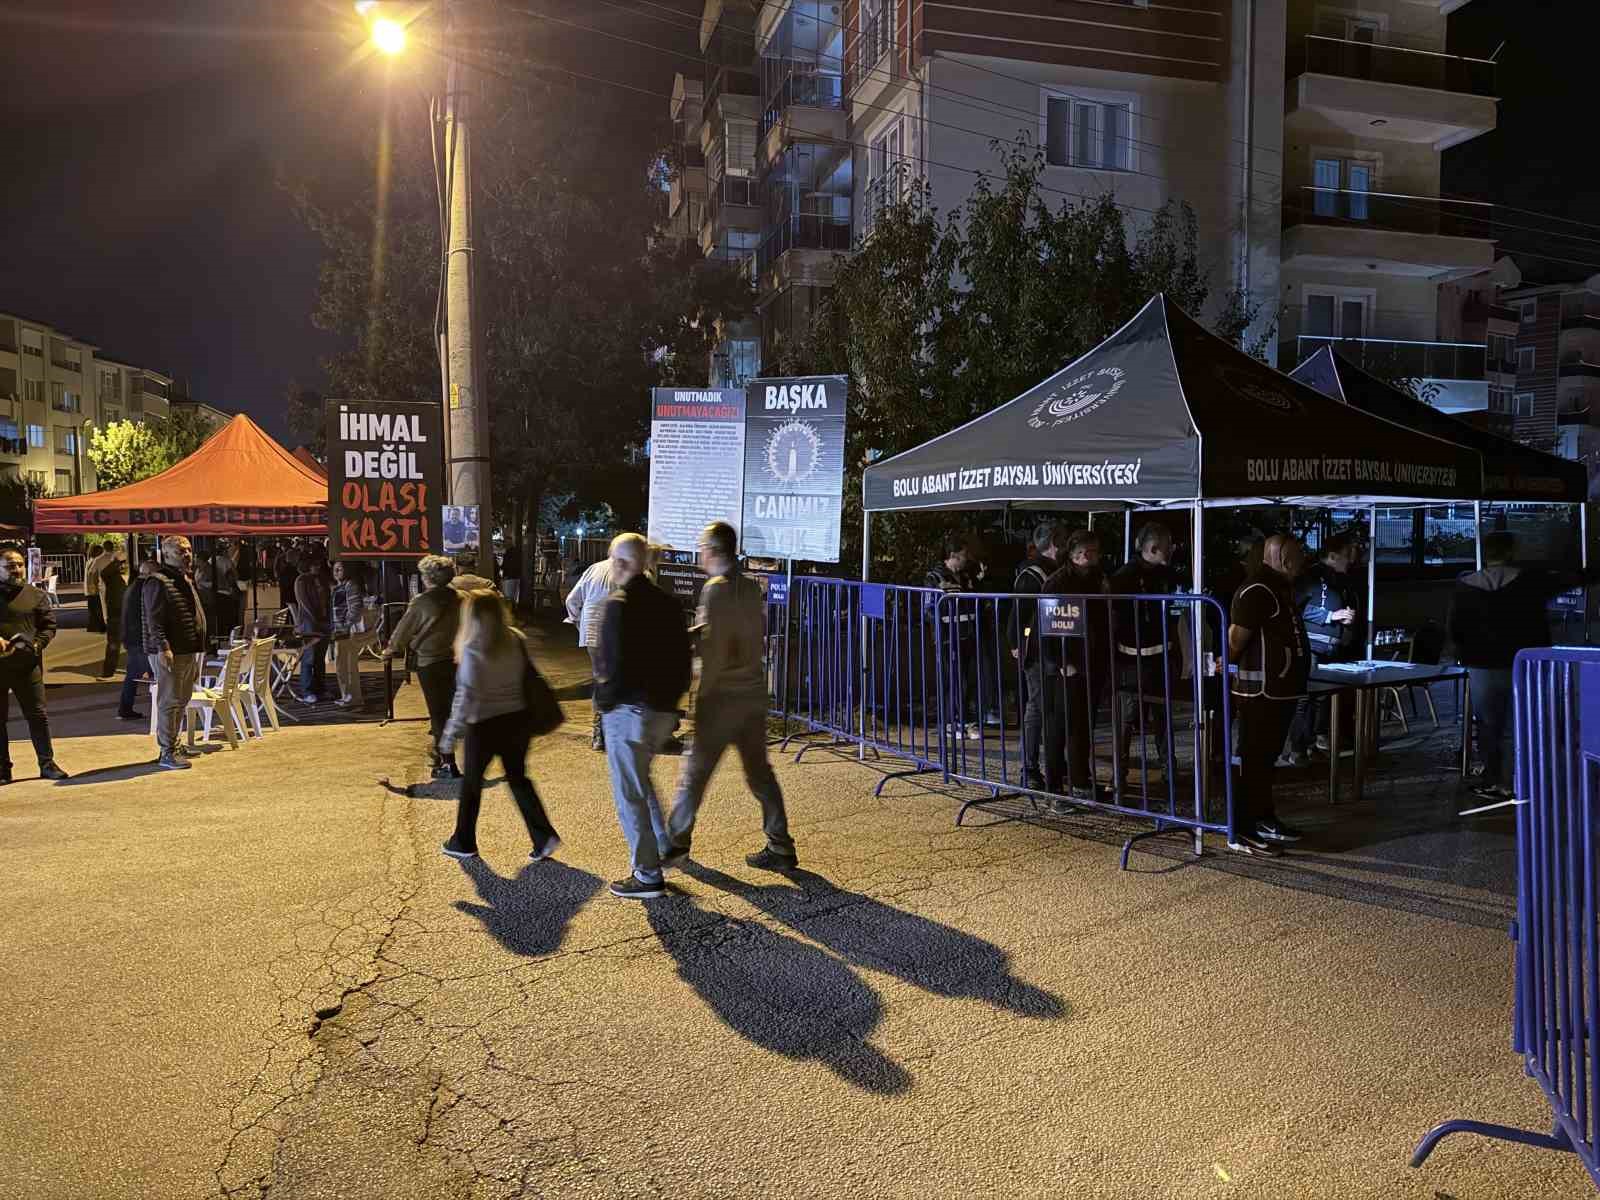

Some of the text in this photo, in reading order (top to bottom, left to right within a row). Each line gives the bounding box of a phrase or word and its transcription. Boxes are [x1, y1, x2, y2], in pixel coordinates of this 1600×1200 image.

[674, 391, 723, 403] UNUTMADIK
[765, 384, 827, 414] BAŞKA
[340, 405, 427, 442] İHMAL
[345, 444, 424, 480] DEĞİL
[893, 457, 1142, 497] BOLU ABANT İZZET BAYSAL ÜNİVERSİTESİ
[1247, 459, 1279, 482] BOLU
[1282, 459, 1320, 481] ABANT
[1322, 454, 1352, 480] İZZET
[1354, 459, 1393, 482] BAYSAL
[342, 482, 429, 515] OLASI
[73, 509, 119, 525] T.C.
[128, 508, 200, 525] BOLU
[341, 516, 430, 551] KAST!
[1045, 603, 1081, 618] POLİS
[1051, 620, 1075, 630] BOLU
